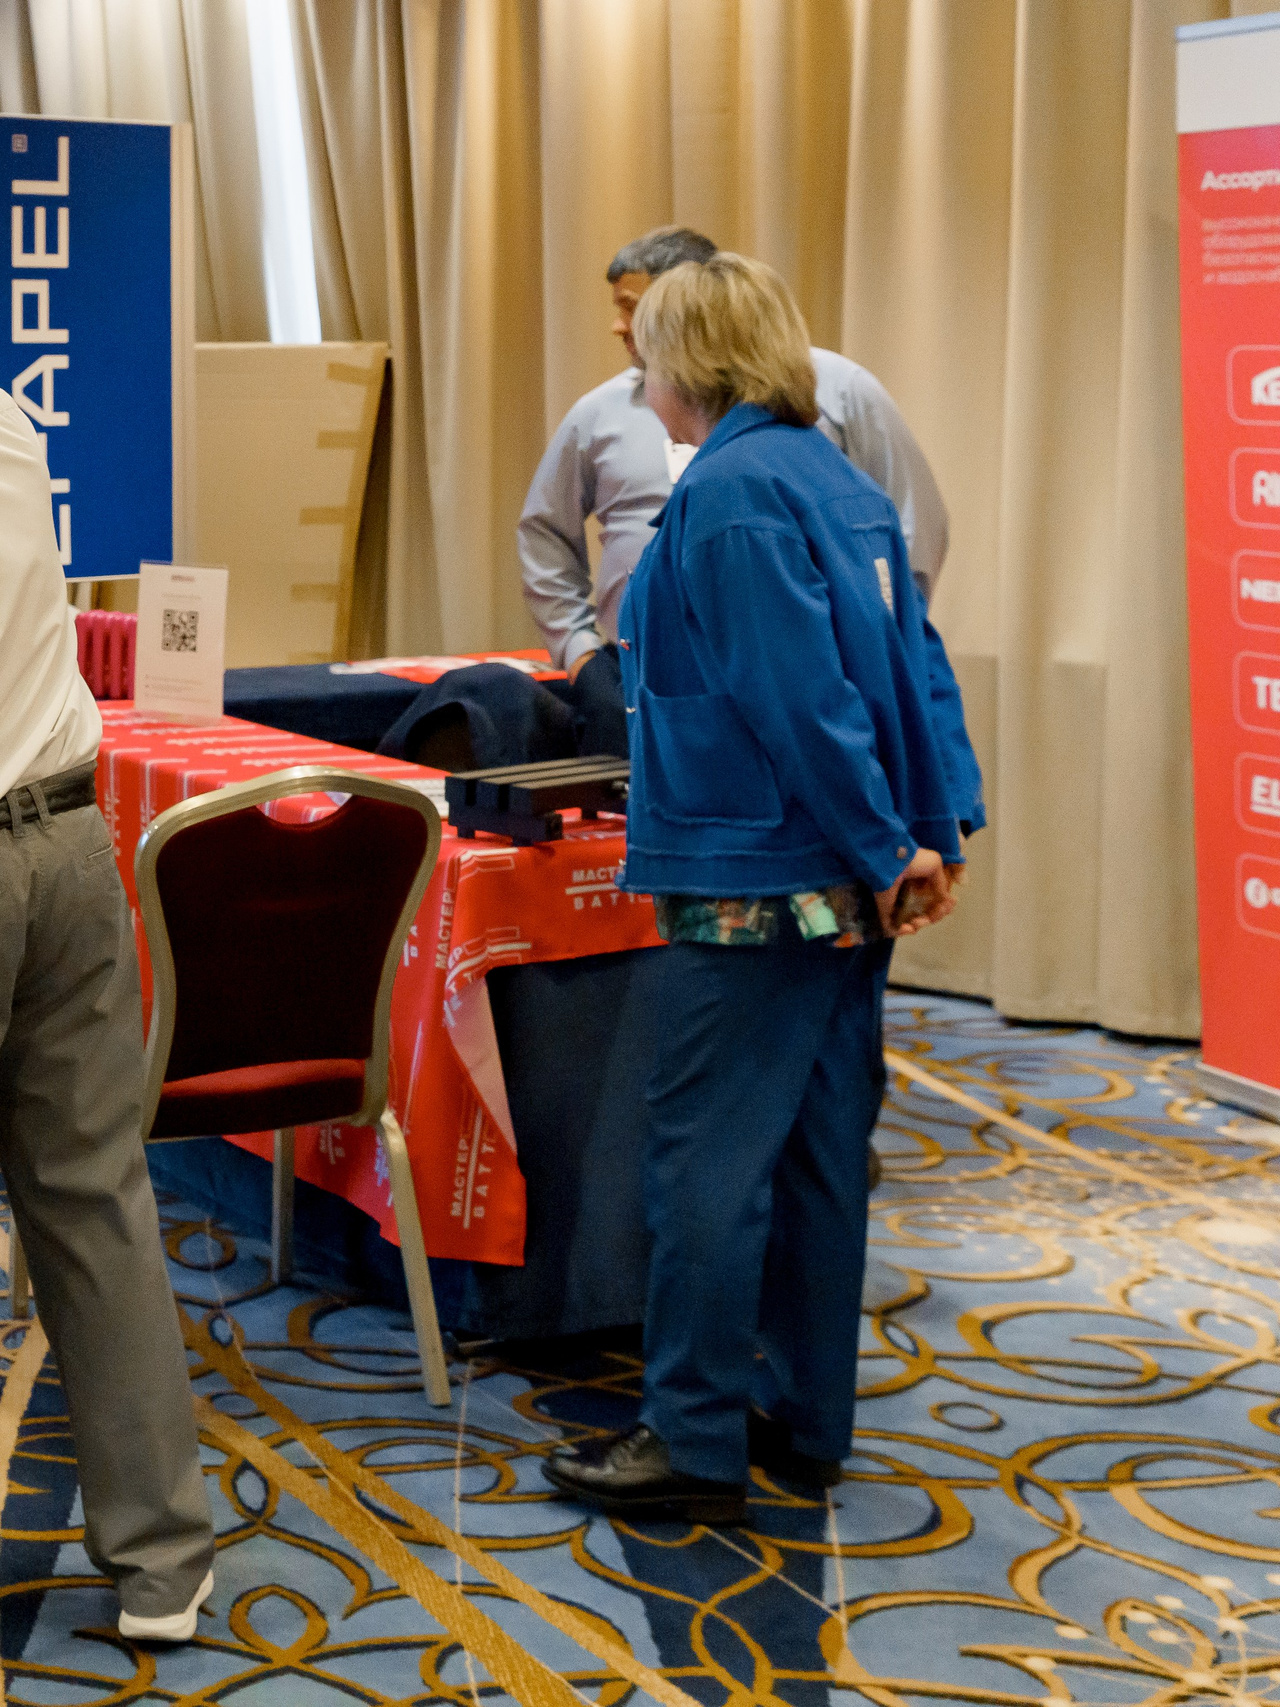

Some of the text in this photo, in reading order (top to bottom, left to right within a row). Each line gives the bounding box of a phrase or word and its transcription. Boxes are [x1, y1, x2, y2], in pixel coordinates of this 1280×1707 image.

[11, 136, 72, 566] APEL
[572, 866, 624, 882] МАСТ
[450, 1138, 469, 1217] МАСТЕР
